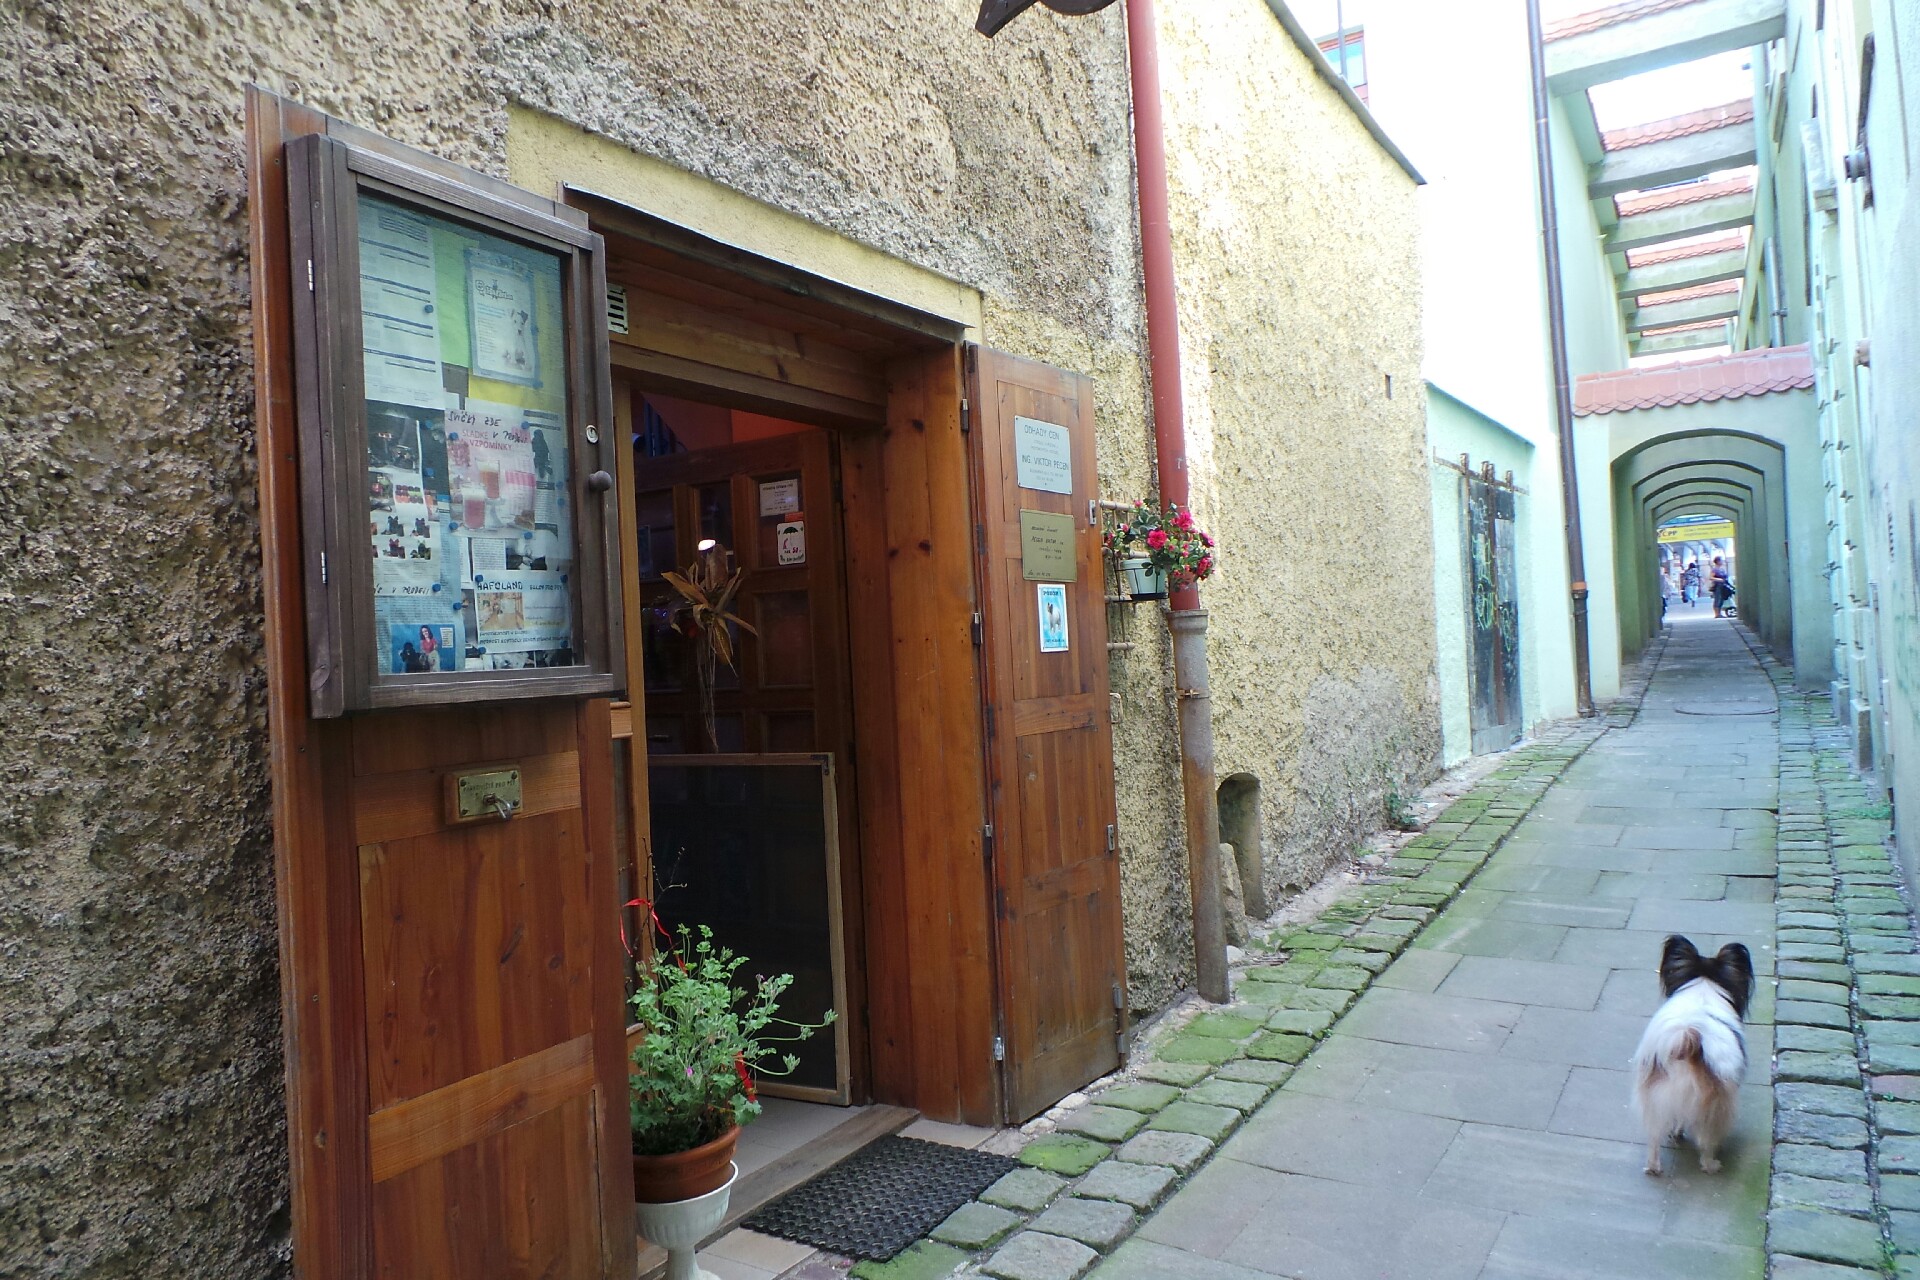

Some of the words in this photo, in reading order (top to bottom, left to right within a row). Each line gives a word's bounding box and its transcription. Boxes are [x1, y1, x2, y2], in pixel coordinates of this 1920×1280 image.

[1023, 424, 1047, 438] ODHADY
[1048, 430, 1060, 441] CEN
[469, 439, 512, 451] VZPOMÍNKY
[1034, 457, 1052, 468] VIKTOR
[477, 580, 523, 591] HAFOLAND
